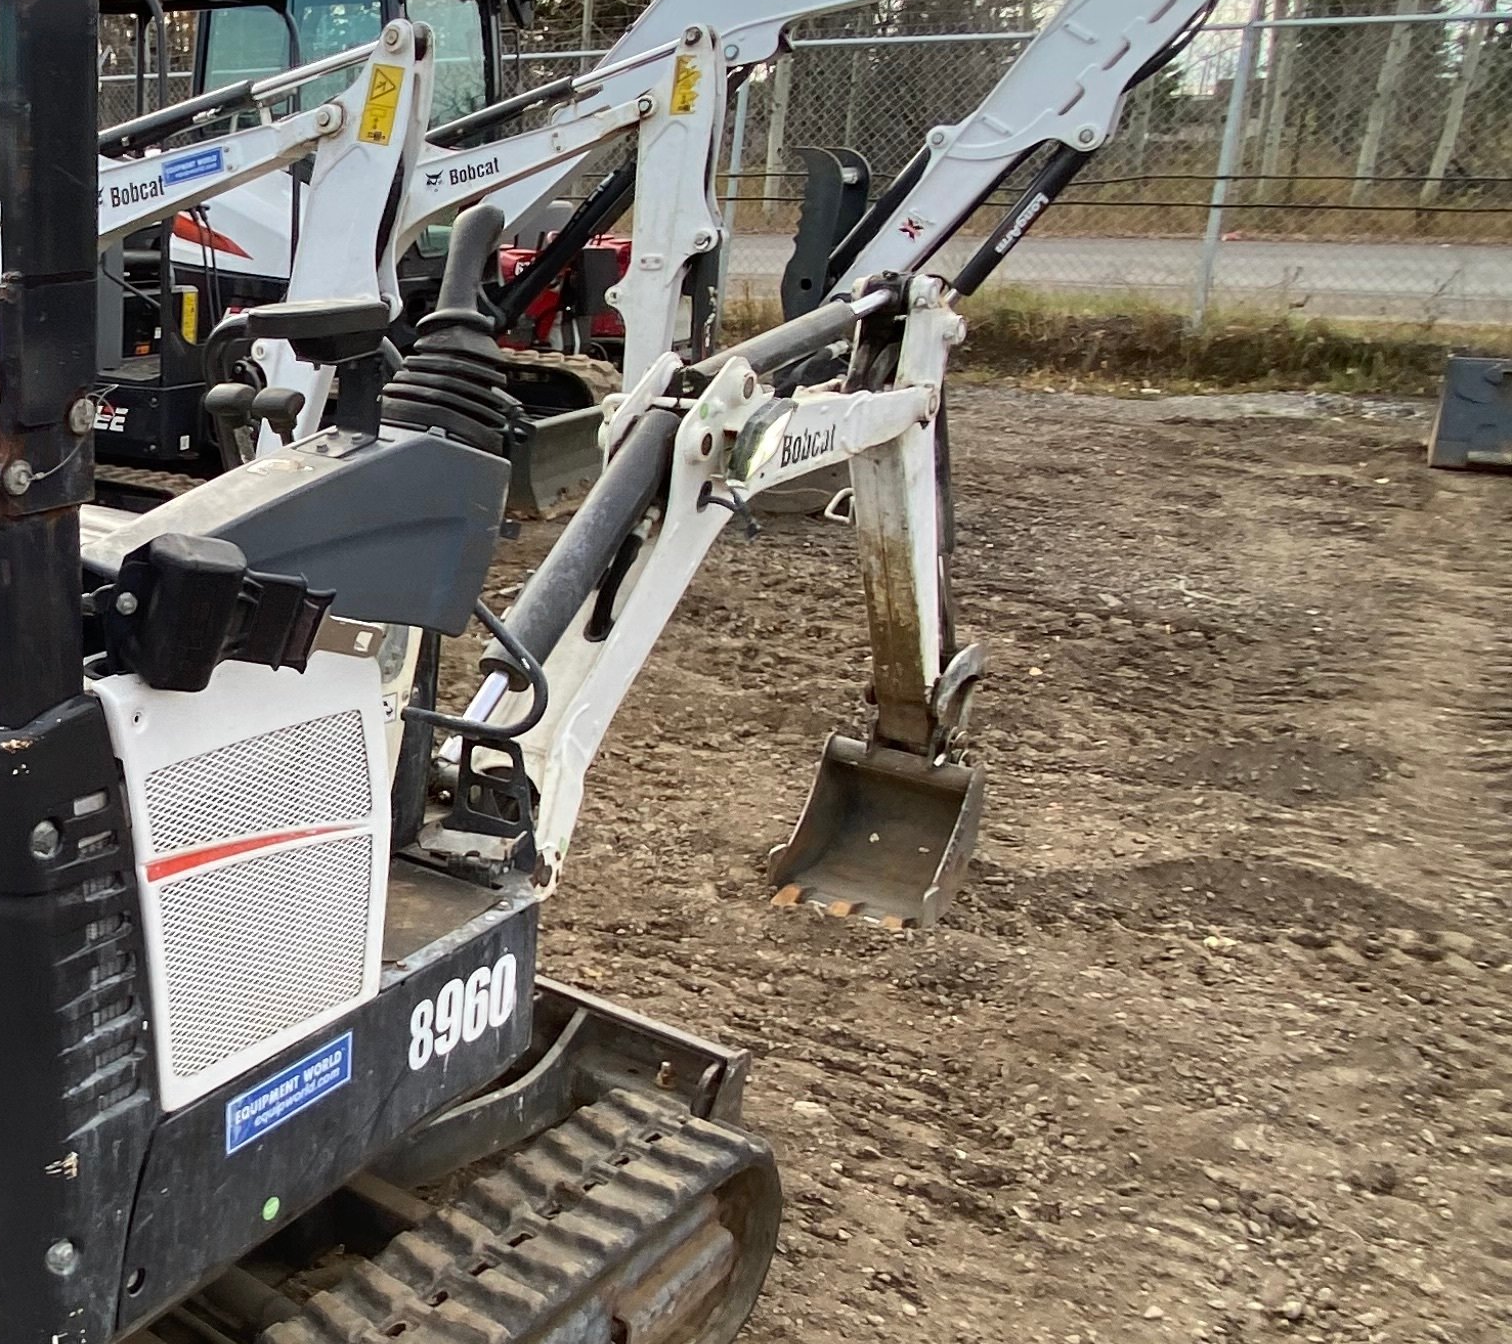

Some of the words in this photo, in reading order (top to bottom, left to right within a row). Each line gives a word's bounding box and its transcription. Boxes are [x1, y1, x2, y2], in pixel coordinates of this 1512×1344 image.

[110, 176, 165, 208] Bobcat
[449, 157, 500, 185] Bobcat
[408, 953, 517, 1071] 8960
[234, 1074, 300, 1126] EQUIPMENT
